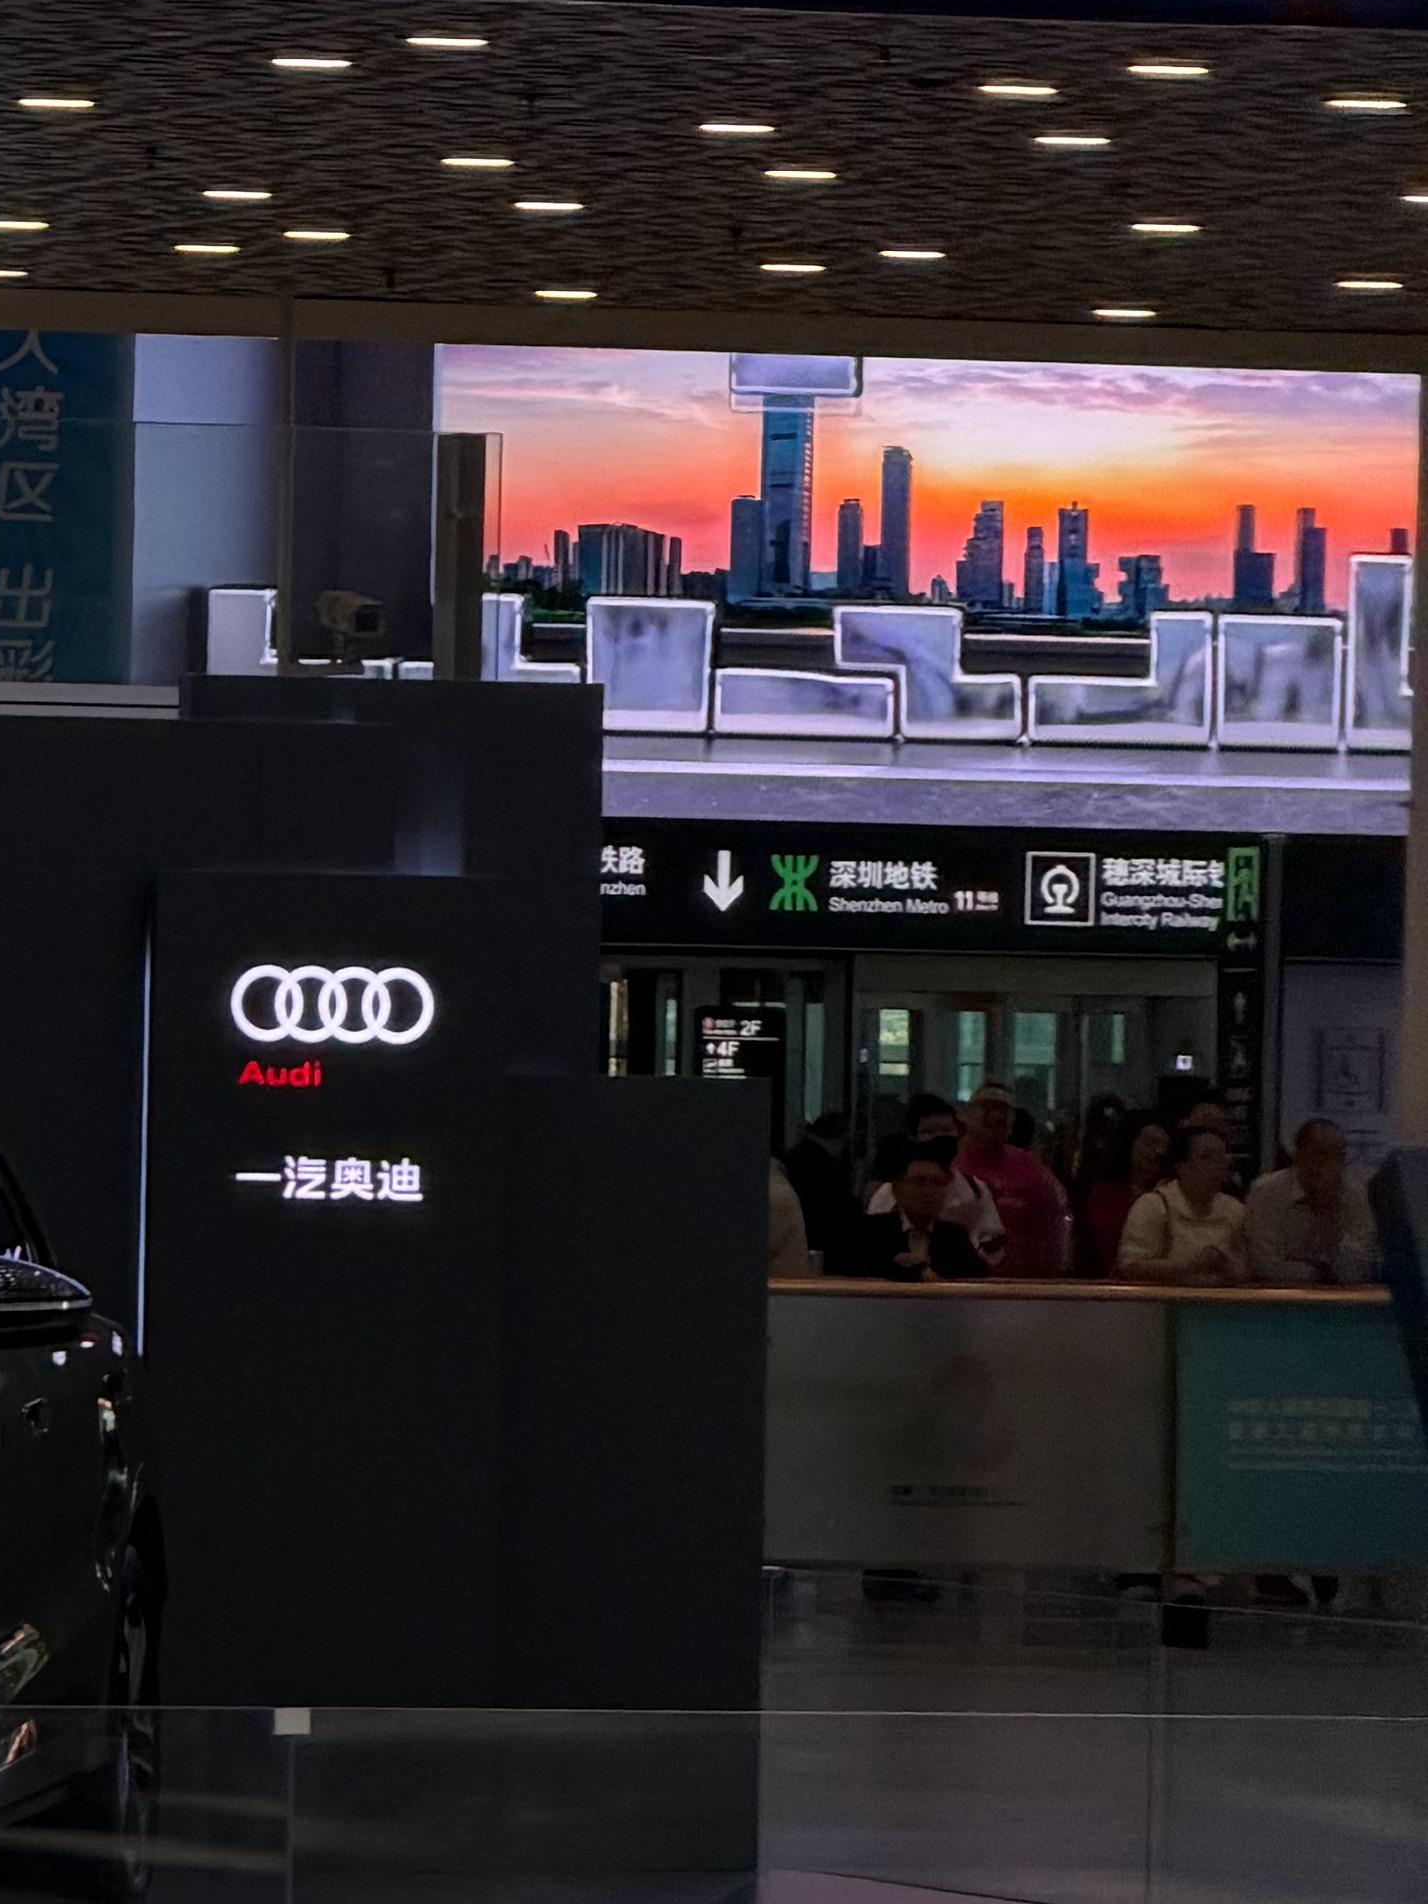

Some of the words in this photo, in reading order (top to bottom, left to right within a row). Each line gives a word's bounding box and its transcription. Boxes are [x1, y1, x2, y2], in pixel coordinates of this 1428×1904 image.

[829, 860, 939, 891] 深圳地铁
[828, 896, 903, 914] Shenzhen
[905, 897, 950, 915] Metro
[740, 1019, 763, 1037] 2F
[716, 1040, 741, 1057] 4F
[237, 1060, 322, 1088] Audi
[235, 1155, 424, 1202] 一汽奥迪
